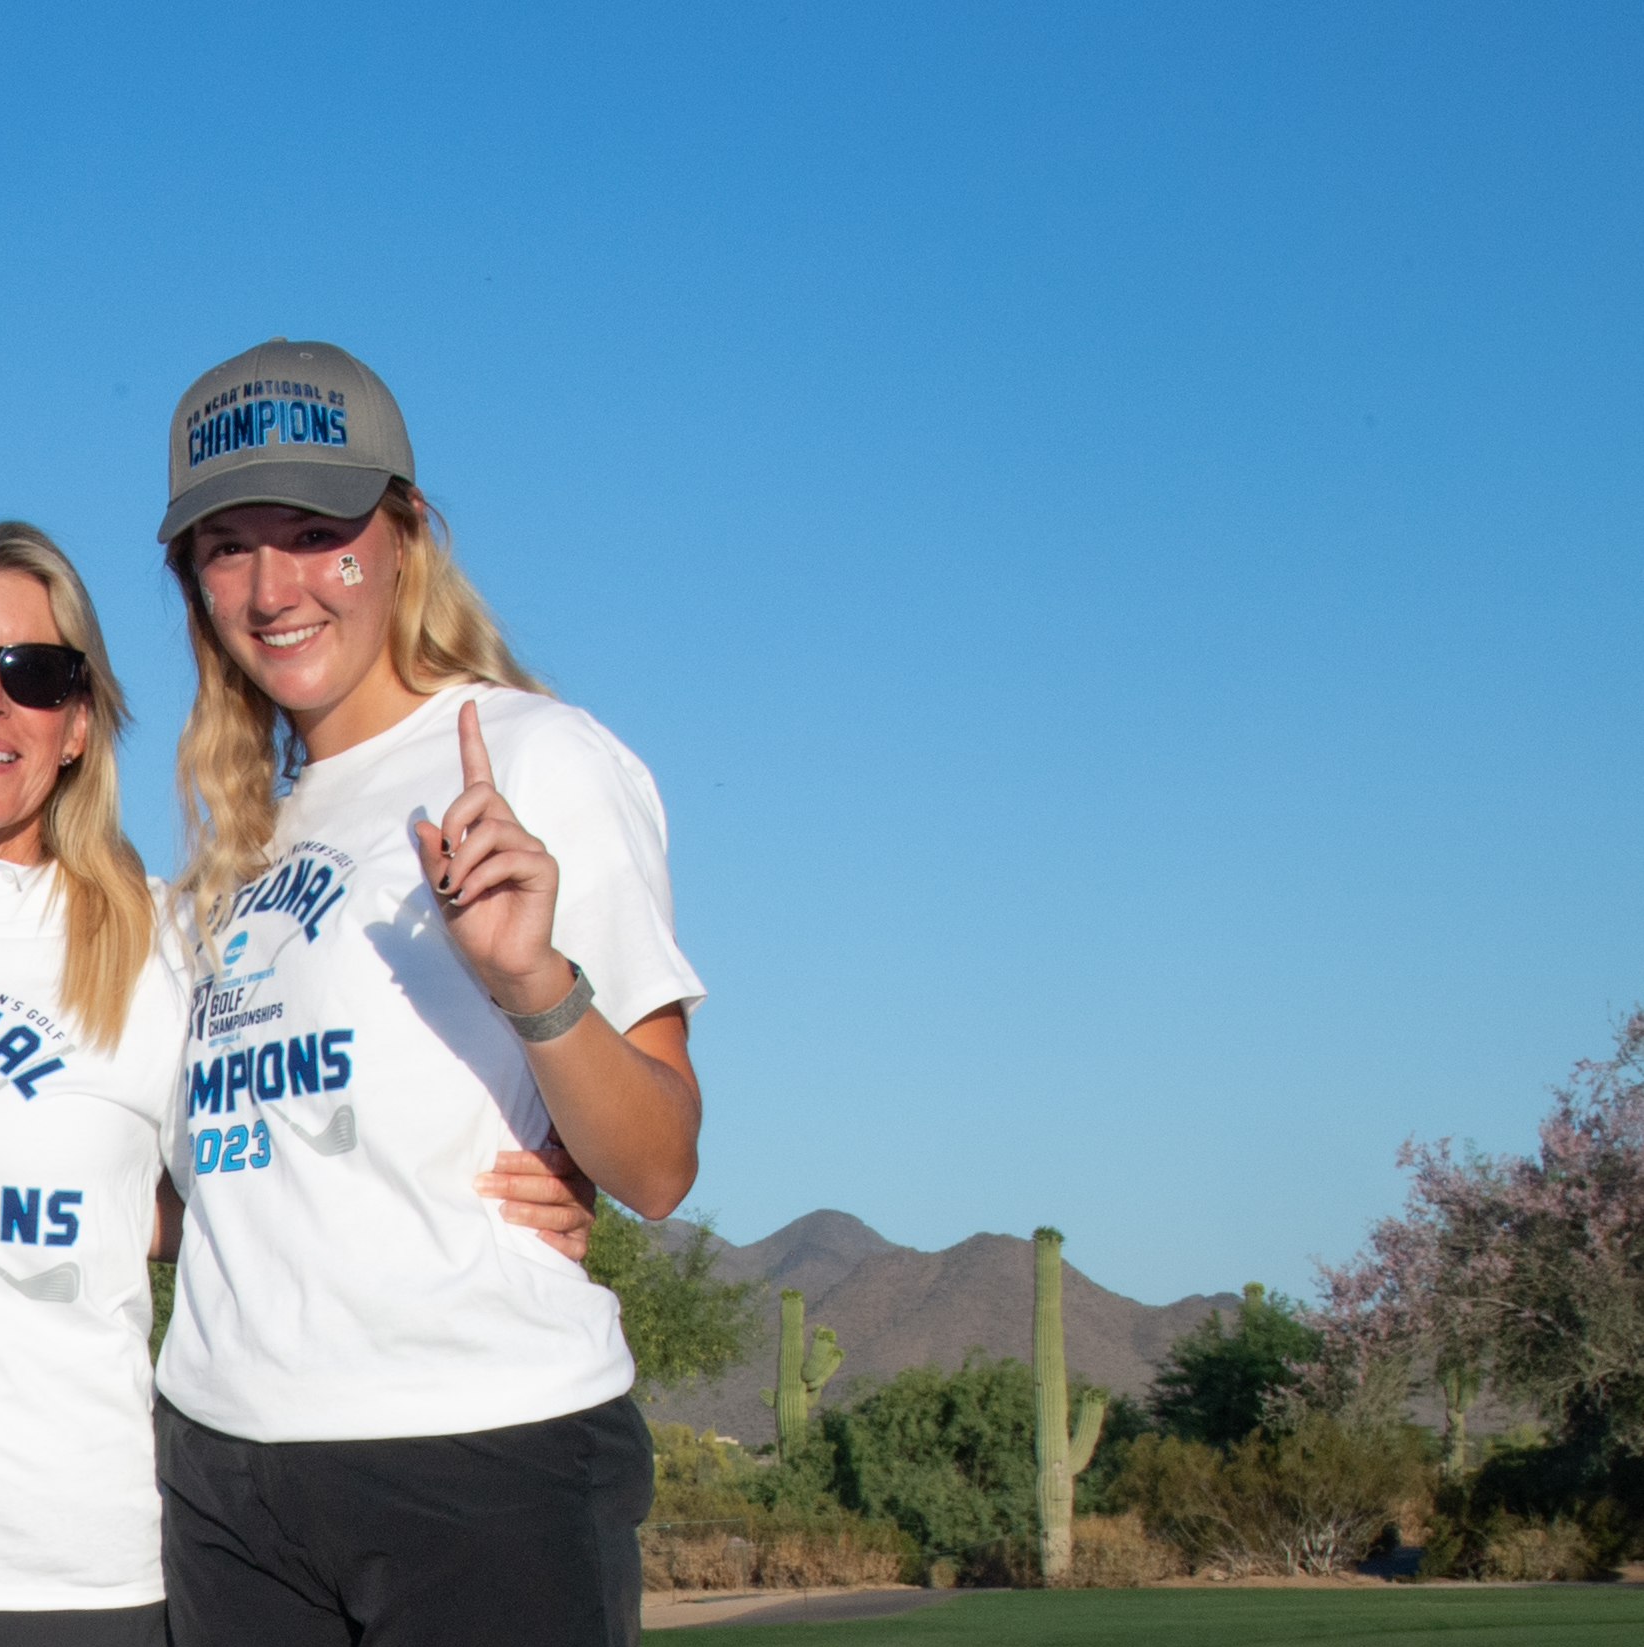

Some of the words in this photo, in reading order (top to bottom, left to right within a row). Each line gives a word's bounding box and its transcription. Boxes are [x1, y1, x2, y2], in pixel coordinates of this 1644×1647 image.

[188, 399, 348, 469] CHAMPIONS
[26, 1008, 65, 1041] GOLF
[208, 1002, 283, 1037] CHAMPIONSHIPS
[210, 987, 244, 1017] GOLF
[188, 1028, 355, 1118] MPIONS
[191, 1119, 272, 1175] 023
